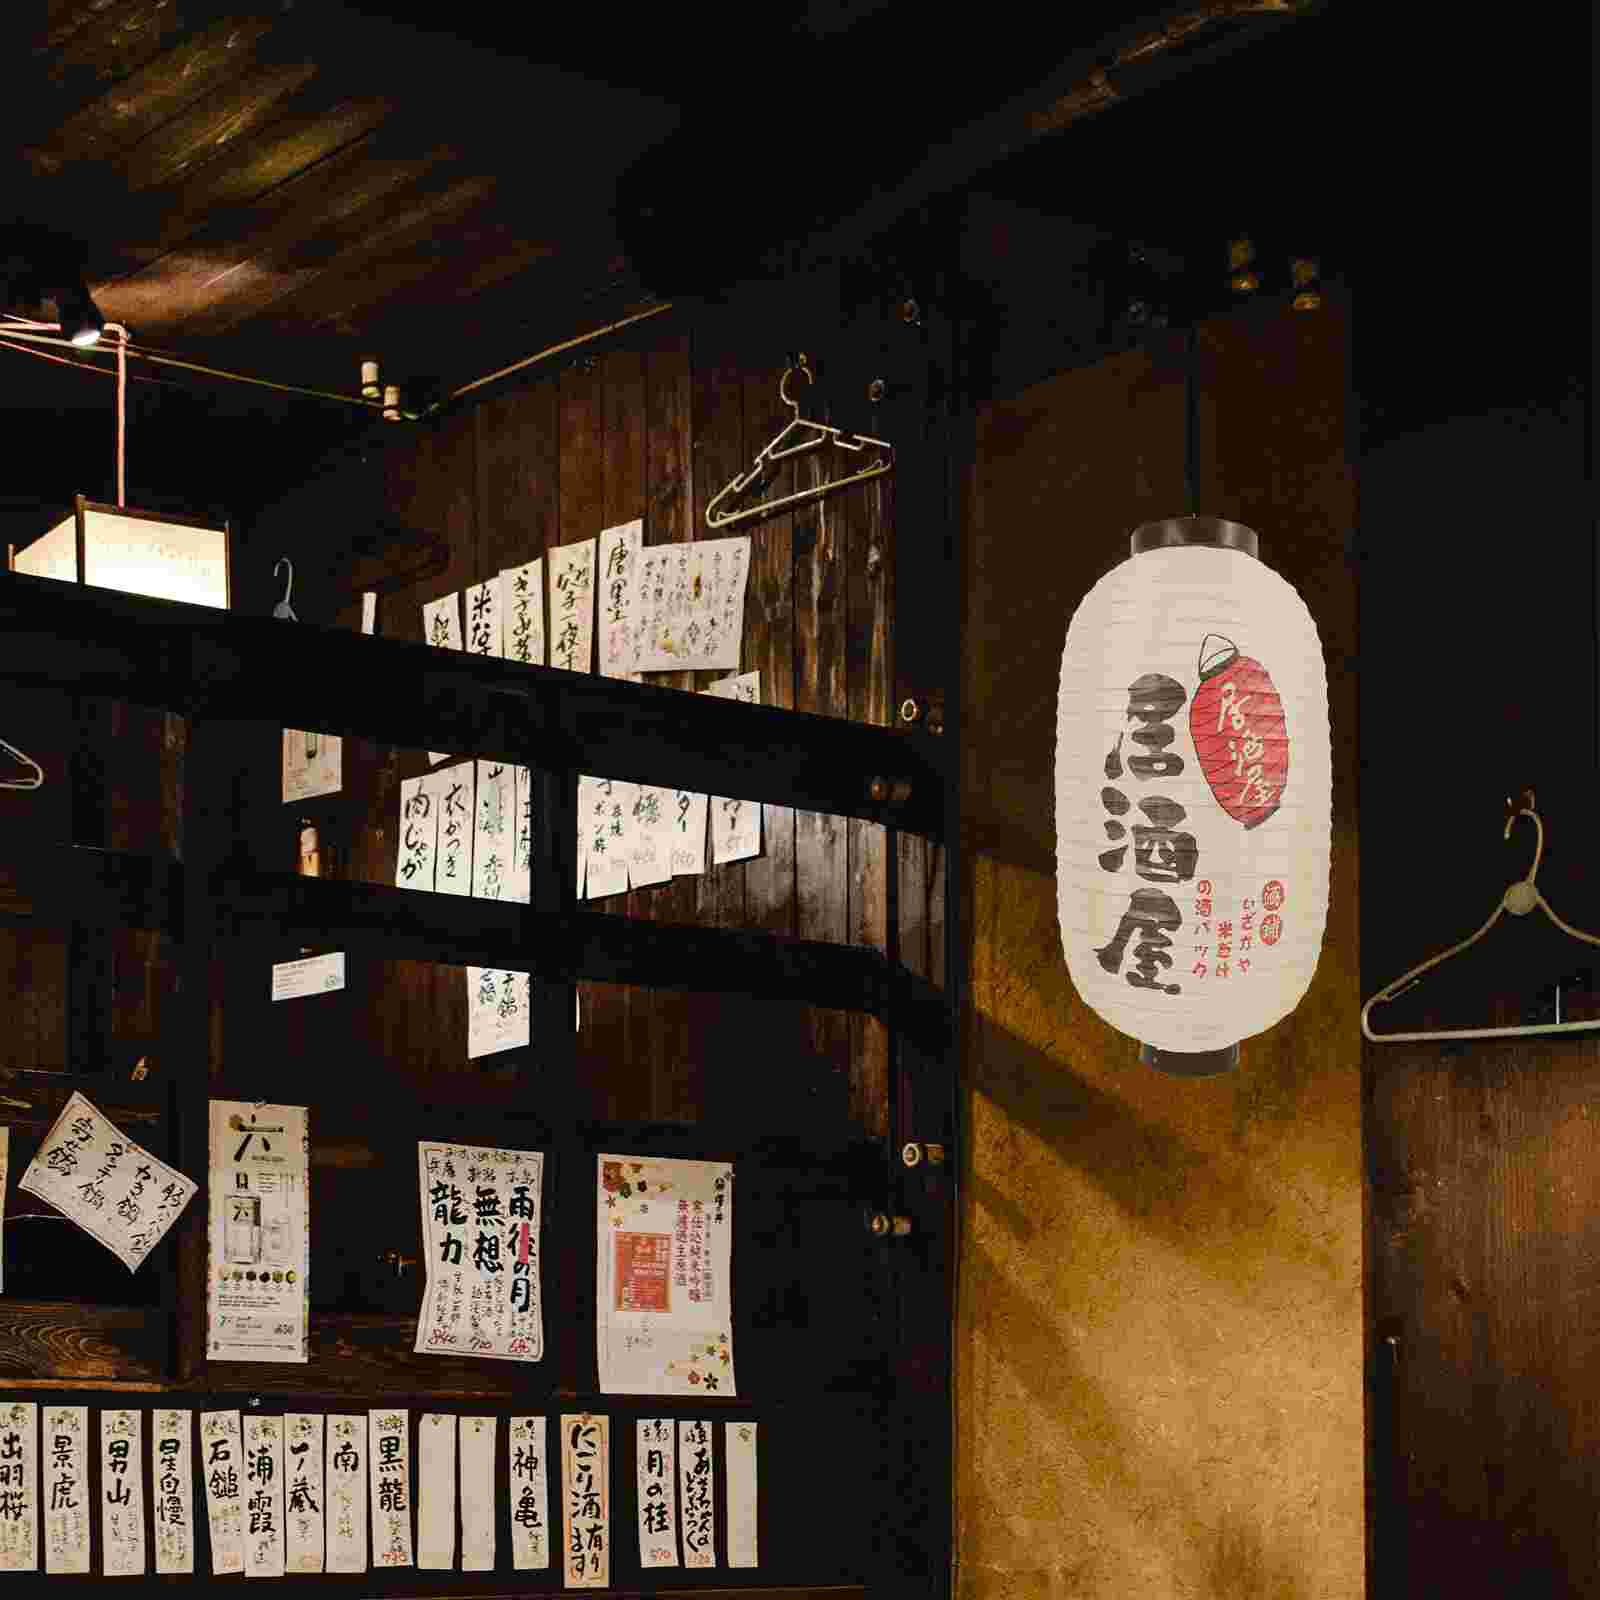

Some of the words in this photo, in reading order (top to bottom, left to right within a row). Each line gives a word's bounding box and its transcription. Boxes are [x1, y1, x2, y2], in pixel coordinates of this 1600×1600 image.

[401, 784, 430, 880] 肉じゃが
[1094, 673, 1199, 994] 居酒屋
[1192, 879, 1212, 979] の酒パック
[1238, 897, 1256, 973] いざかや
[430, 1180, 467, 1265] 龍力
[0, 1432, 28, 1520] 出羽桜
[51, 1435, 78, 1511] 景虎
[106, 1439, 130, 1506] 男山
[156, 1438, 185, 1527] 星自慢
[247, 1445, 277, 1535] 浦霞
[334, 1442, 359, 1473] 南
[378, 1436, 407, 1512] 黒龍
[642, 1450, 670, 1534] 月の桂
